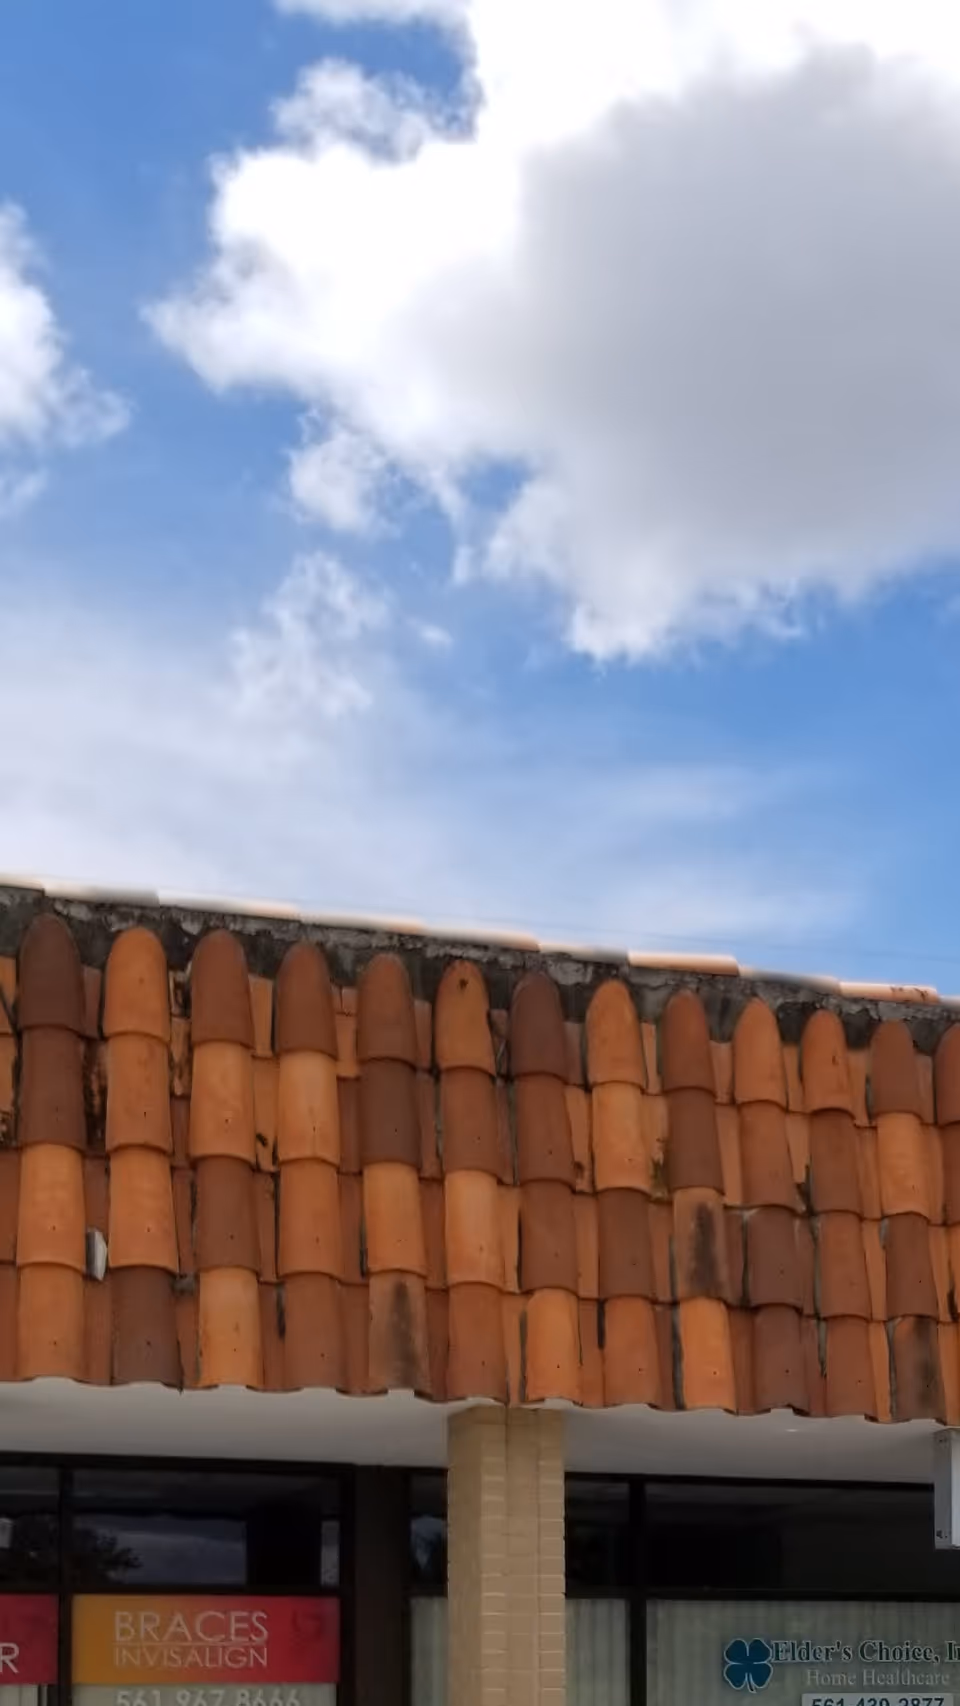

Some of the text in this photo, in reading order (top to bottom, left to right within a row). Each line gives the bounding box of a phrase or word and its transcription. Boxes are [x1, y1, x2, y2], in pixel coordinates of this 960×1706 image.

[115, 1610, 269, 1642] BRACES
[115, 1647, 268, 1669] INVISALIGN
[771, 1640, 852, 1663] Elder's
[859, 1640, 940, 1664] Choice,
[806, 1669, 950, 1687] Home Healthcare
